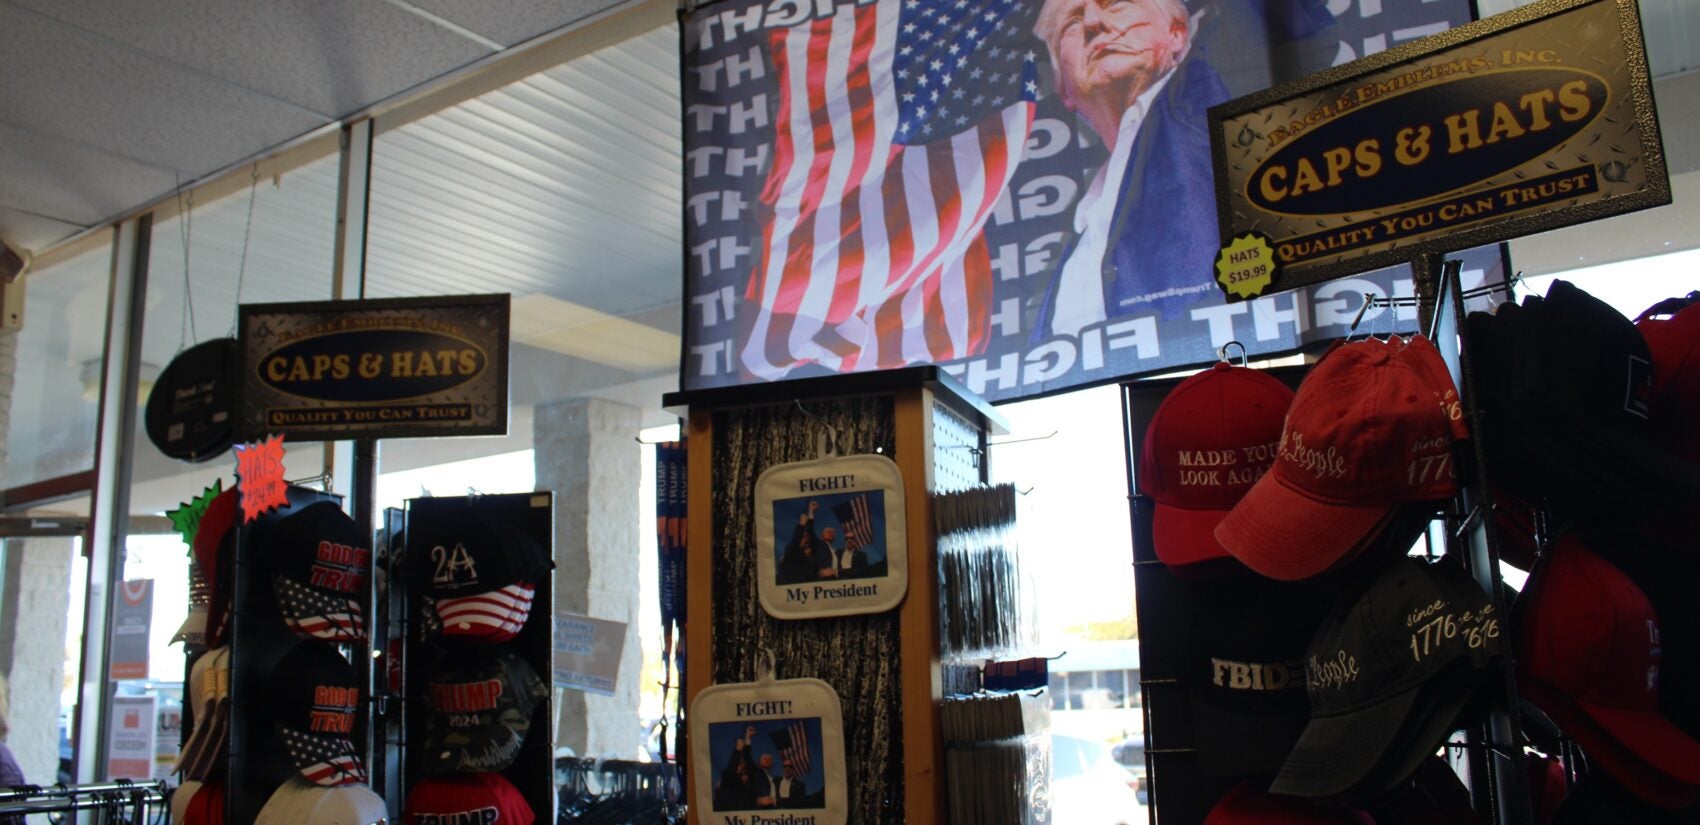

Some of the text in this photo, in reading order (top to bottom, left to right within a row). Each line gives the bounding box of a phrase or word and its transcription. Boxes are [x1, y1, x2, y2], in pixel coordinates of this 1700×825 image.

[1267, 49, 1563, 146] EAGLE EMBLEMS, INC.
[1259, 79, 1591, 203] CAPS & HATS
[1278, 174, 1591, 262] QUALITY YOU CAN TRUST
[1229, 247, 1259, 266] HATS
[1229, 264, 1267, 284] $19.99
[267, 349, 477, 382] CAPS & HATS
[271, 406, 468, 426] QUALITY YOU CAN TRUST
[1178, 450, 1237, 467] MADE
[799, 475, 855, 493] FIGHT!
[1179, 463, 1272, 486] LOOK AGA
[431, 542, 478, 582] 2A
[786, 583, 878, 604] My President
[1406, 599, 1446, 628] since
[1410, 613, 1457, 662] 1776
[429, 678, 503, 713] TRUMP
[736, 701, 793, 717] FIGHT!
[310, 710, 355, 734] TRU
[449, 714, 480, 728] 2024
[751, 813, 815, 825] President
